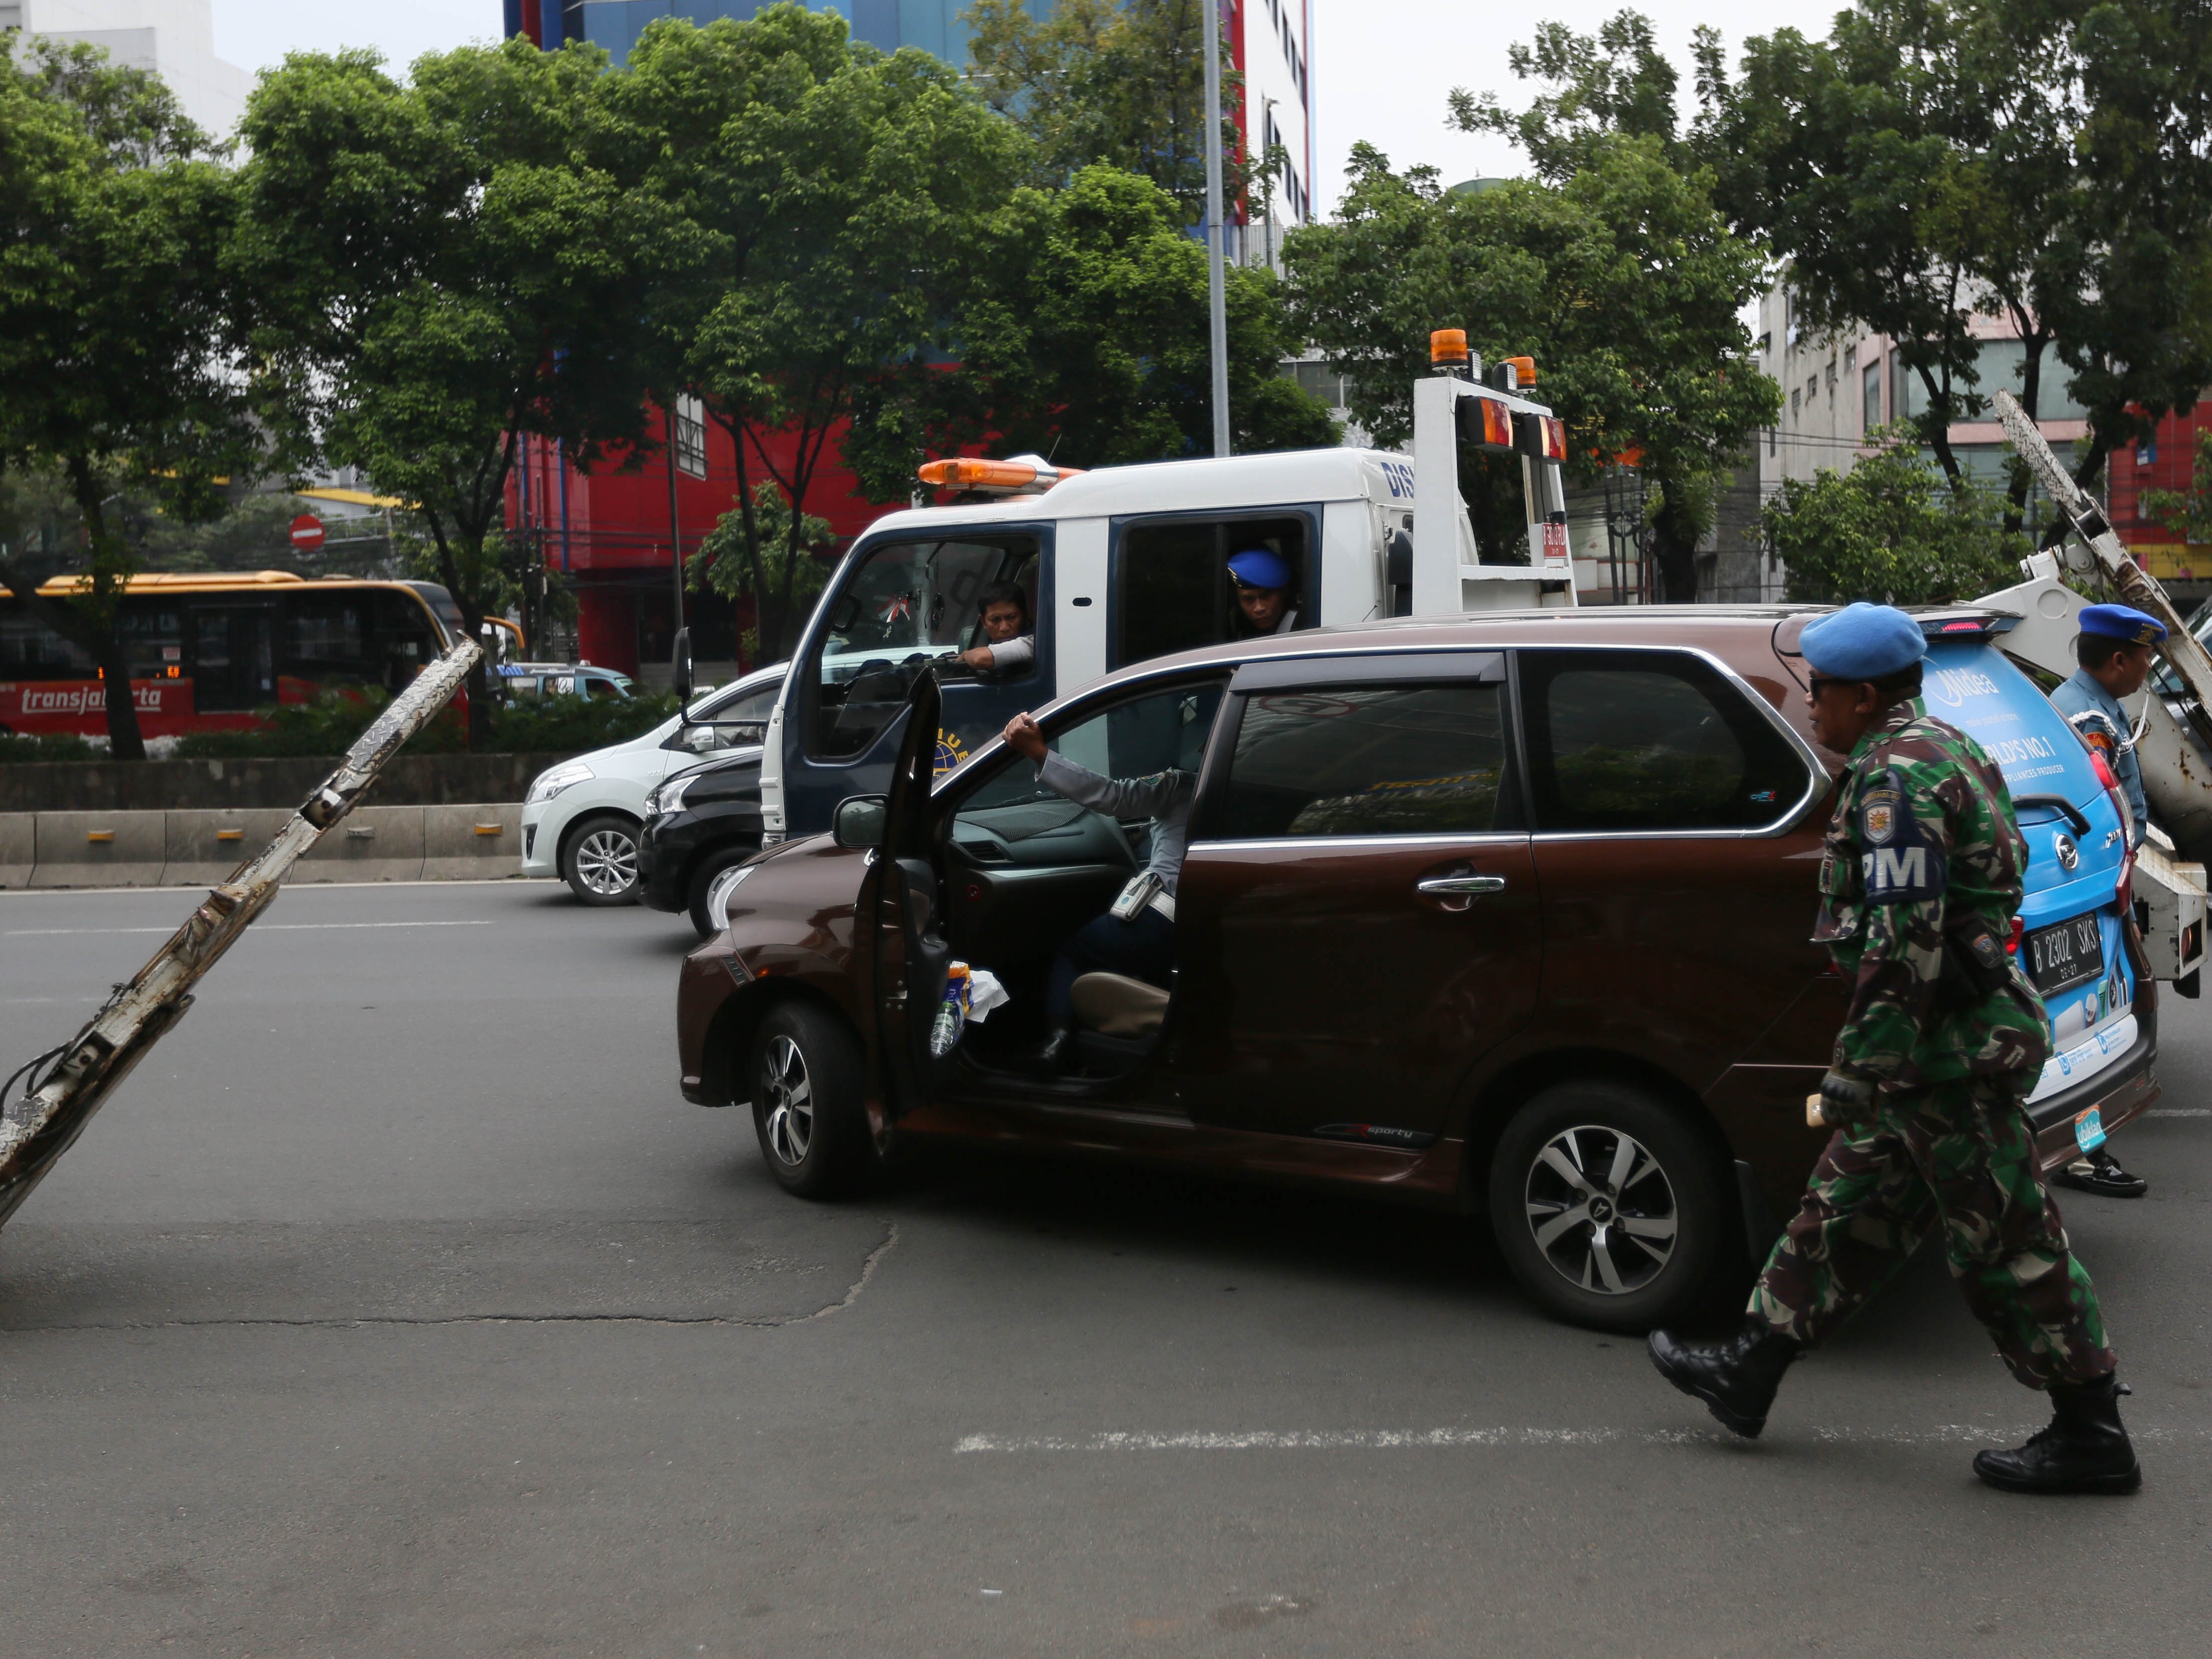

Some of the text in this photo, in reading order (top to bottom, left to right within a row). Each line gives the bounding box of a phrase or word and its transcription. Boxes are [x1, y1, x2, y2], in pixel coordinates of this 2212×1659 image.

[1380, 462, 1414, 498] DIS
[22, 686, 161, 715] transjata
[1933, 668, 1999, 707] Midea
[1982, 739, 2028, 765] RLD'S
[2002, 764, 2065, 783] PPLIANCES PRODUCER
[2033, 920, 2096, 973] B 2302 SKS
[1367, 1127, 1413, 1138] sporty
[2077, 1120, 2103, 1144] ubiklan
